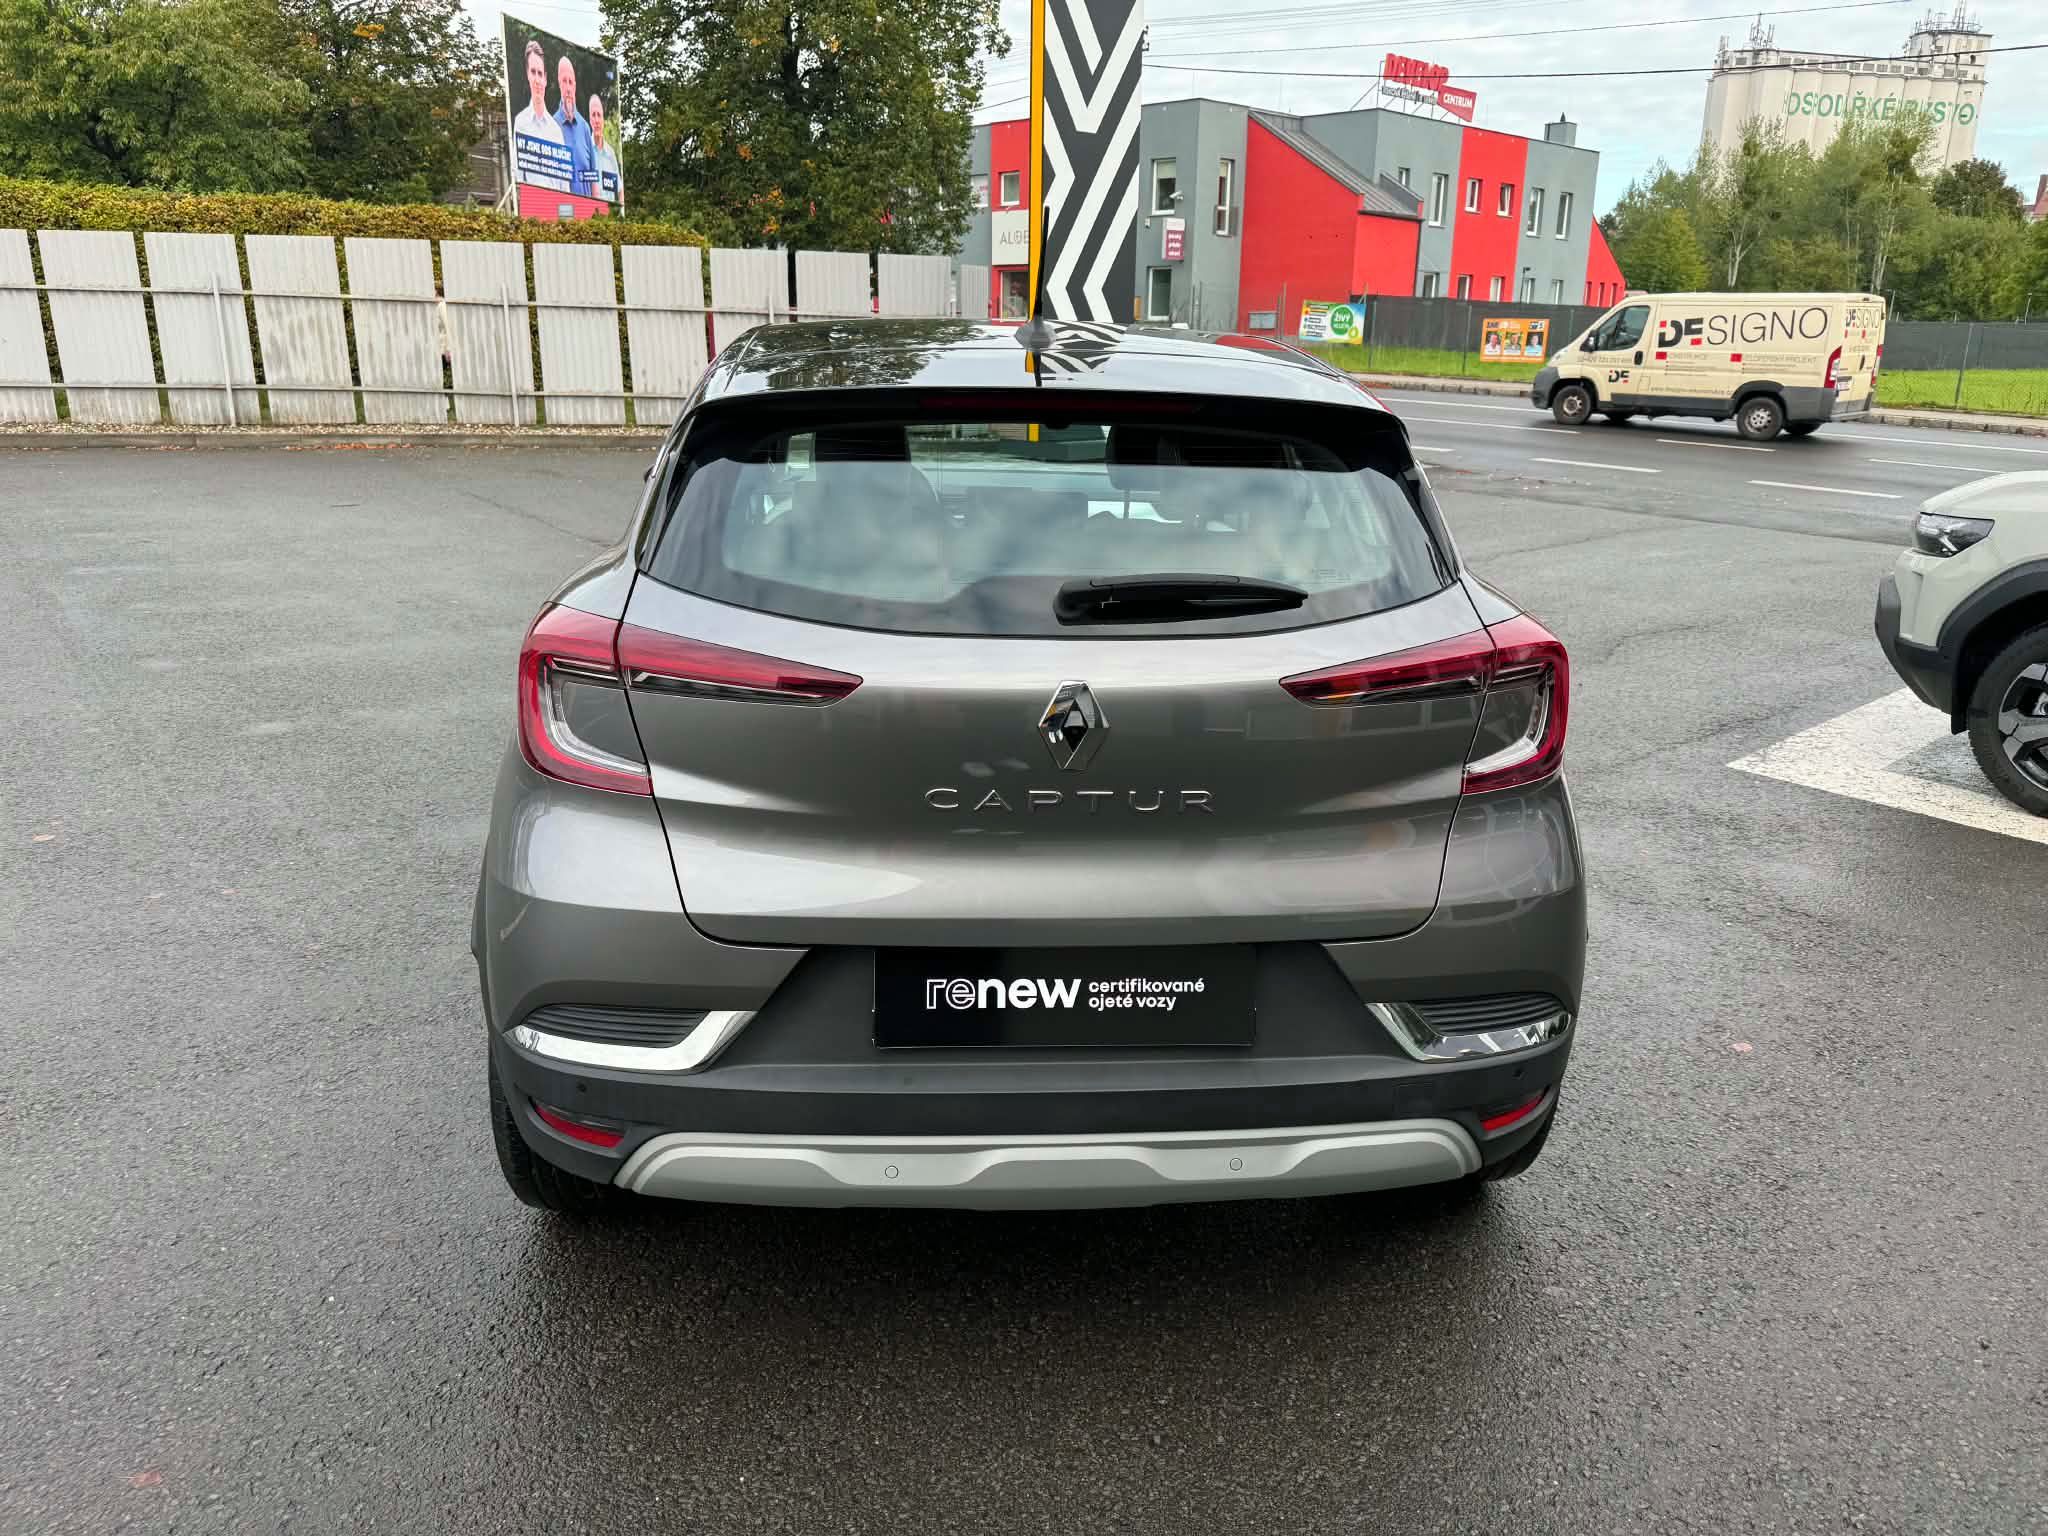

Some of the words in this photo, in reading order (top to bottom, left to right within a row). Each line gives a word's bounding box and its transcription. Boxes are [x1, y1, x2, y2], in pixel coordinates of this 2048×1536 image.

[1443, 93, 1473, 108] CENTRUM
[1657, 307, 1829, 348] DESIGNO
[1608, 369, 1630, 384] DE
[924, 787, 1215, 813] CAPTUR
[926, 978, 1082, 1010] renew
[1088, 977, 1205, 993] certifikované
[1088, 994, 1133, 1012] ojeté
[1136, 996, 1177, 1011] vozy
